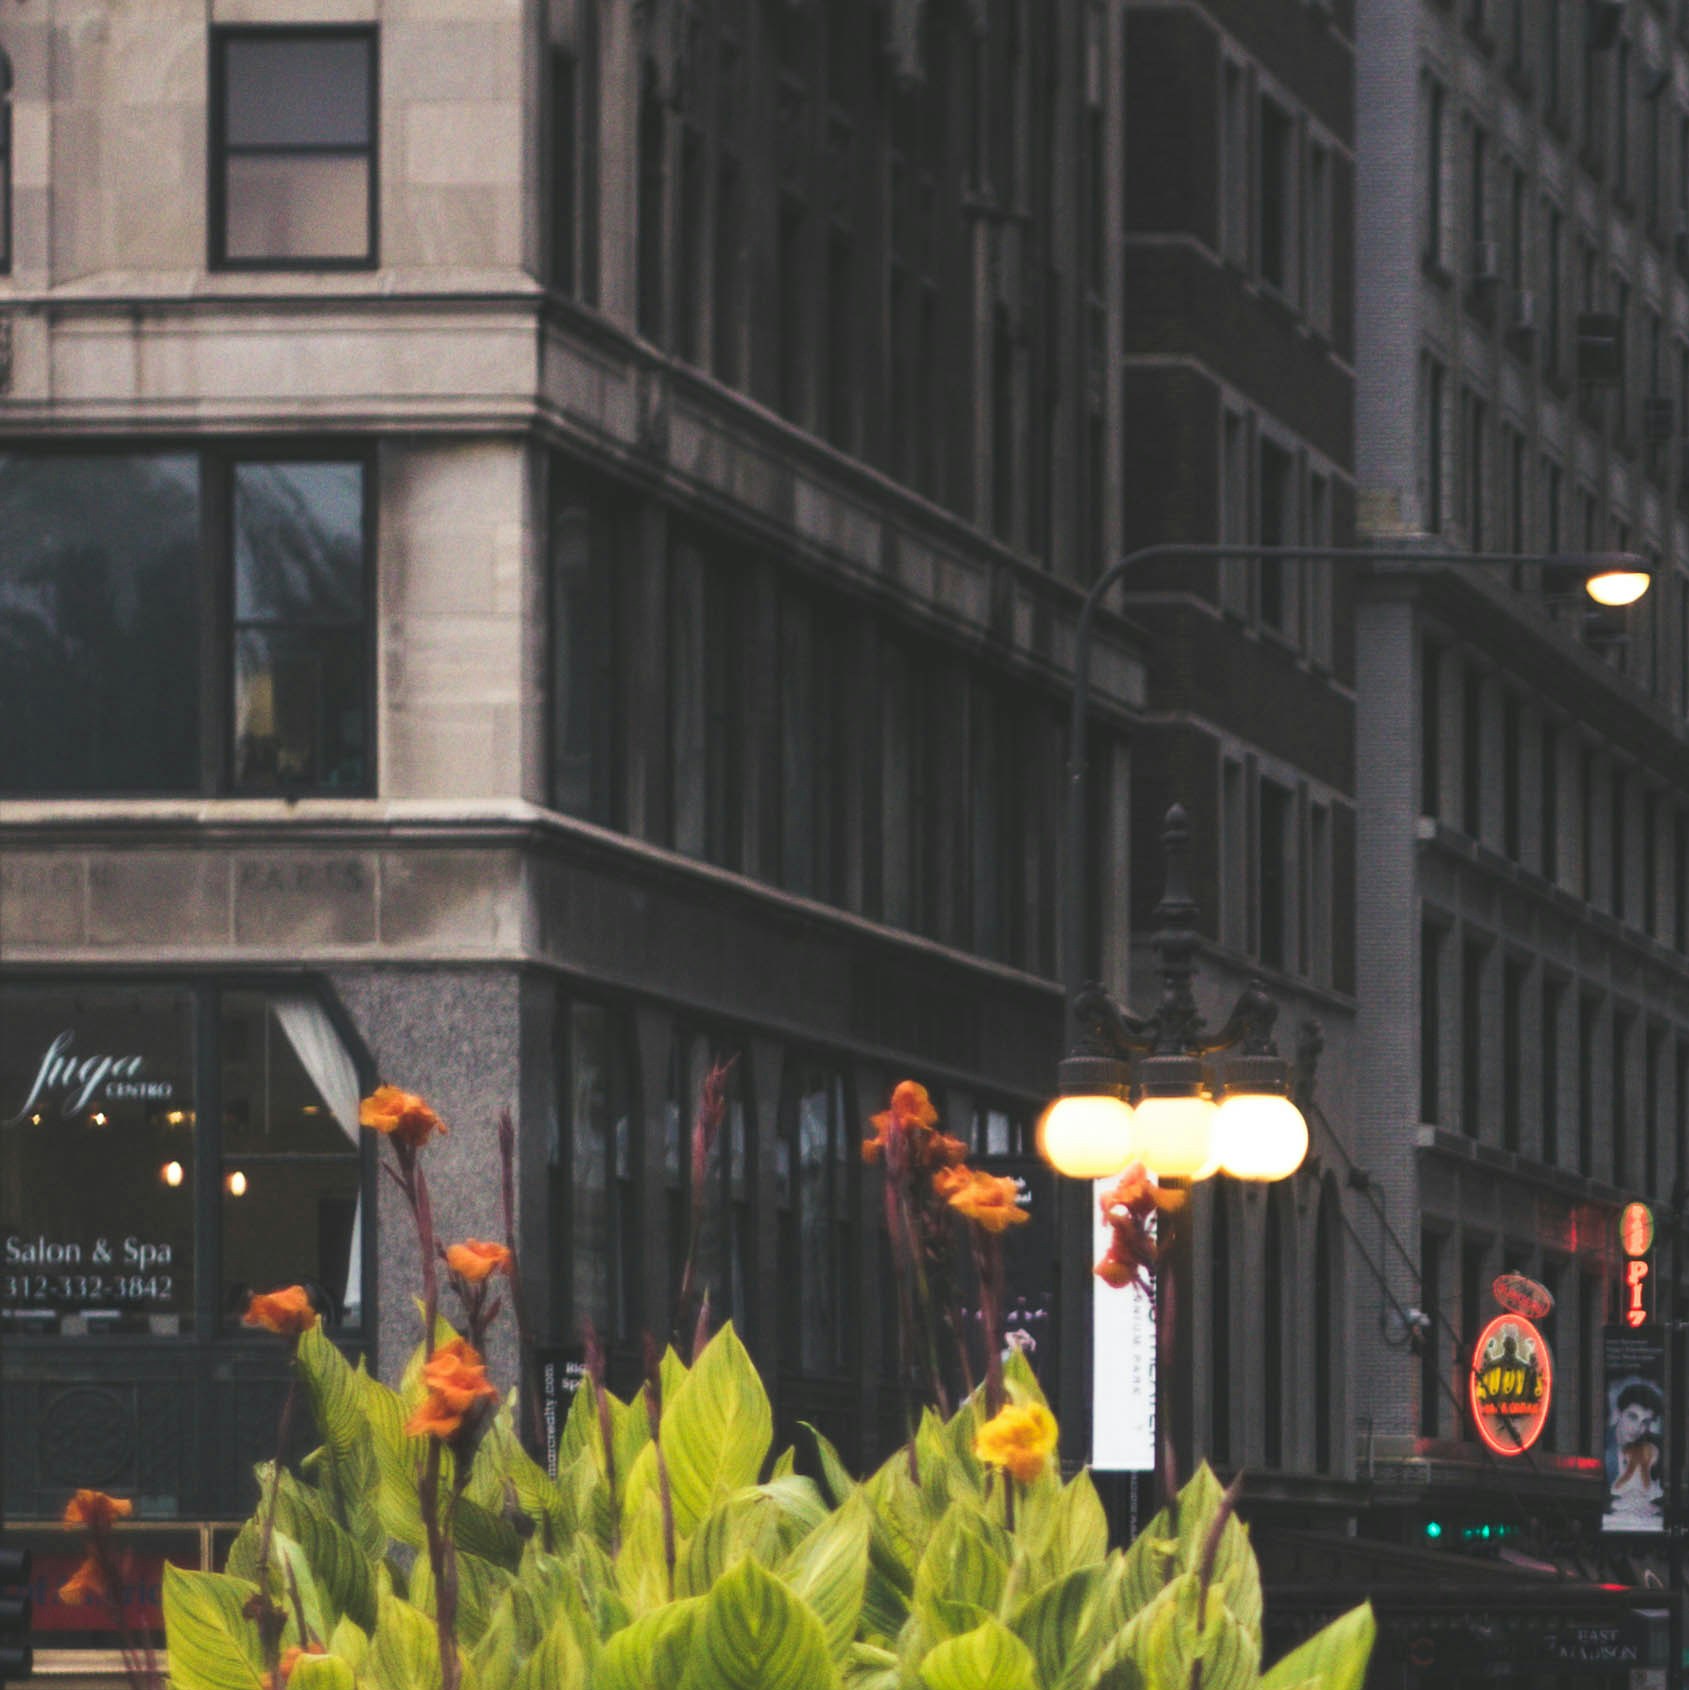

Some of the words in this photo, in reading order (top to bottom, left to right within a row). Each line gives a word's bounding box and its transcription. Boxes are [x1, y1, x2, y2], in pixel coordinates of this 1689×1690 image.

[105, 1082, 172, 1098] CENTRO
[5, 1236, 80, 1264] Salon
[91, 1238, 112, 1264] &
[124, 1237, 172, 1271] Spa
[5, 1276, 172, 1299] 312-332-3842
